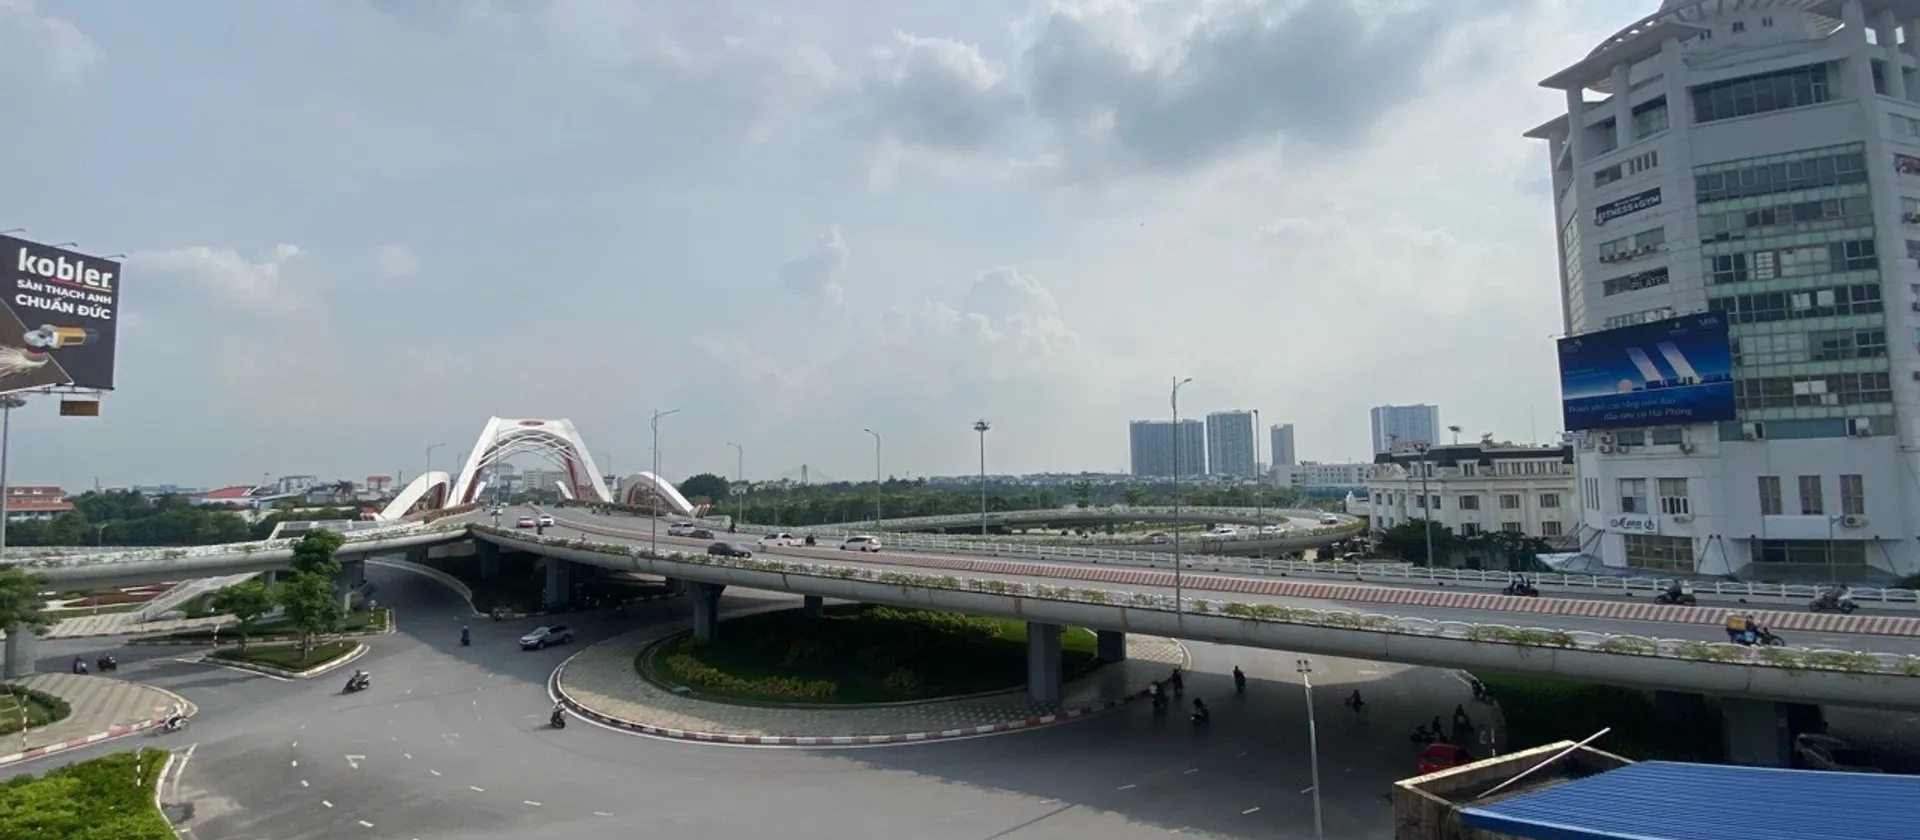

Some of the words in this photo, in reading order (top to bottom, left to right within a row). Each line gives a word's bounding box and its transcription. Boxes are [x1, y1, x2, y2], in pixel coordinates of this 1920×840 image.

[18, 247, 113, 288] kobler
[44, 284, 85, 299] THẠCH
[87, 293, 112, 305] ANH
[77, 303, 111, 319] ĐỨC
